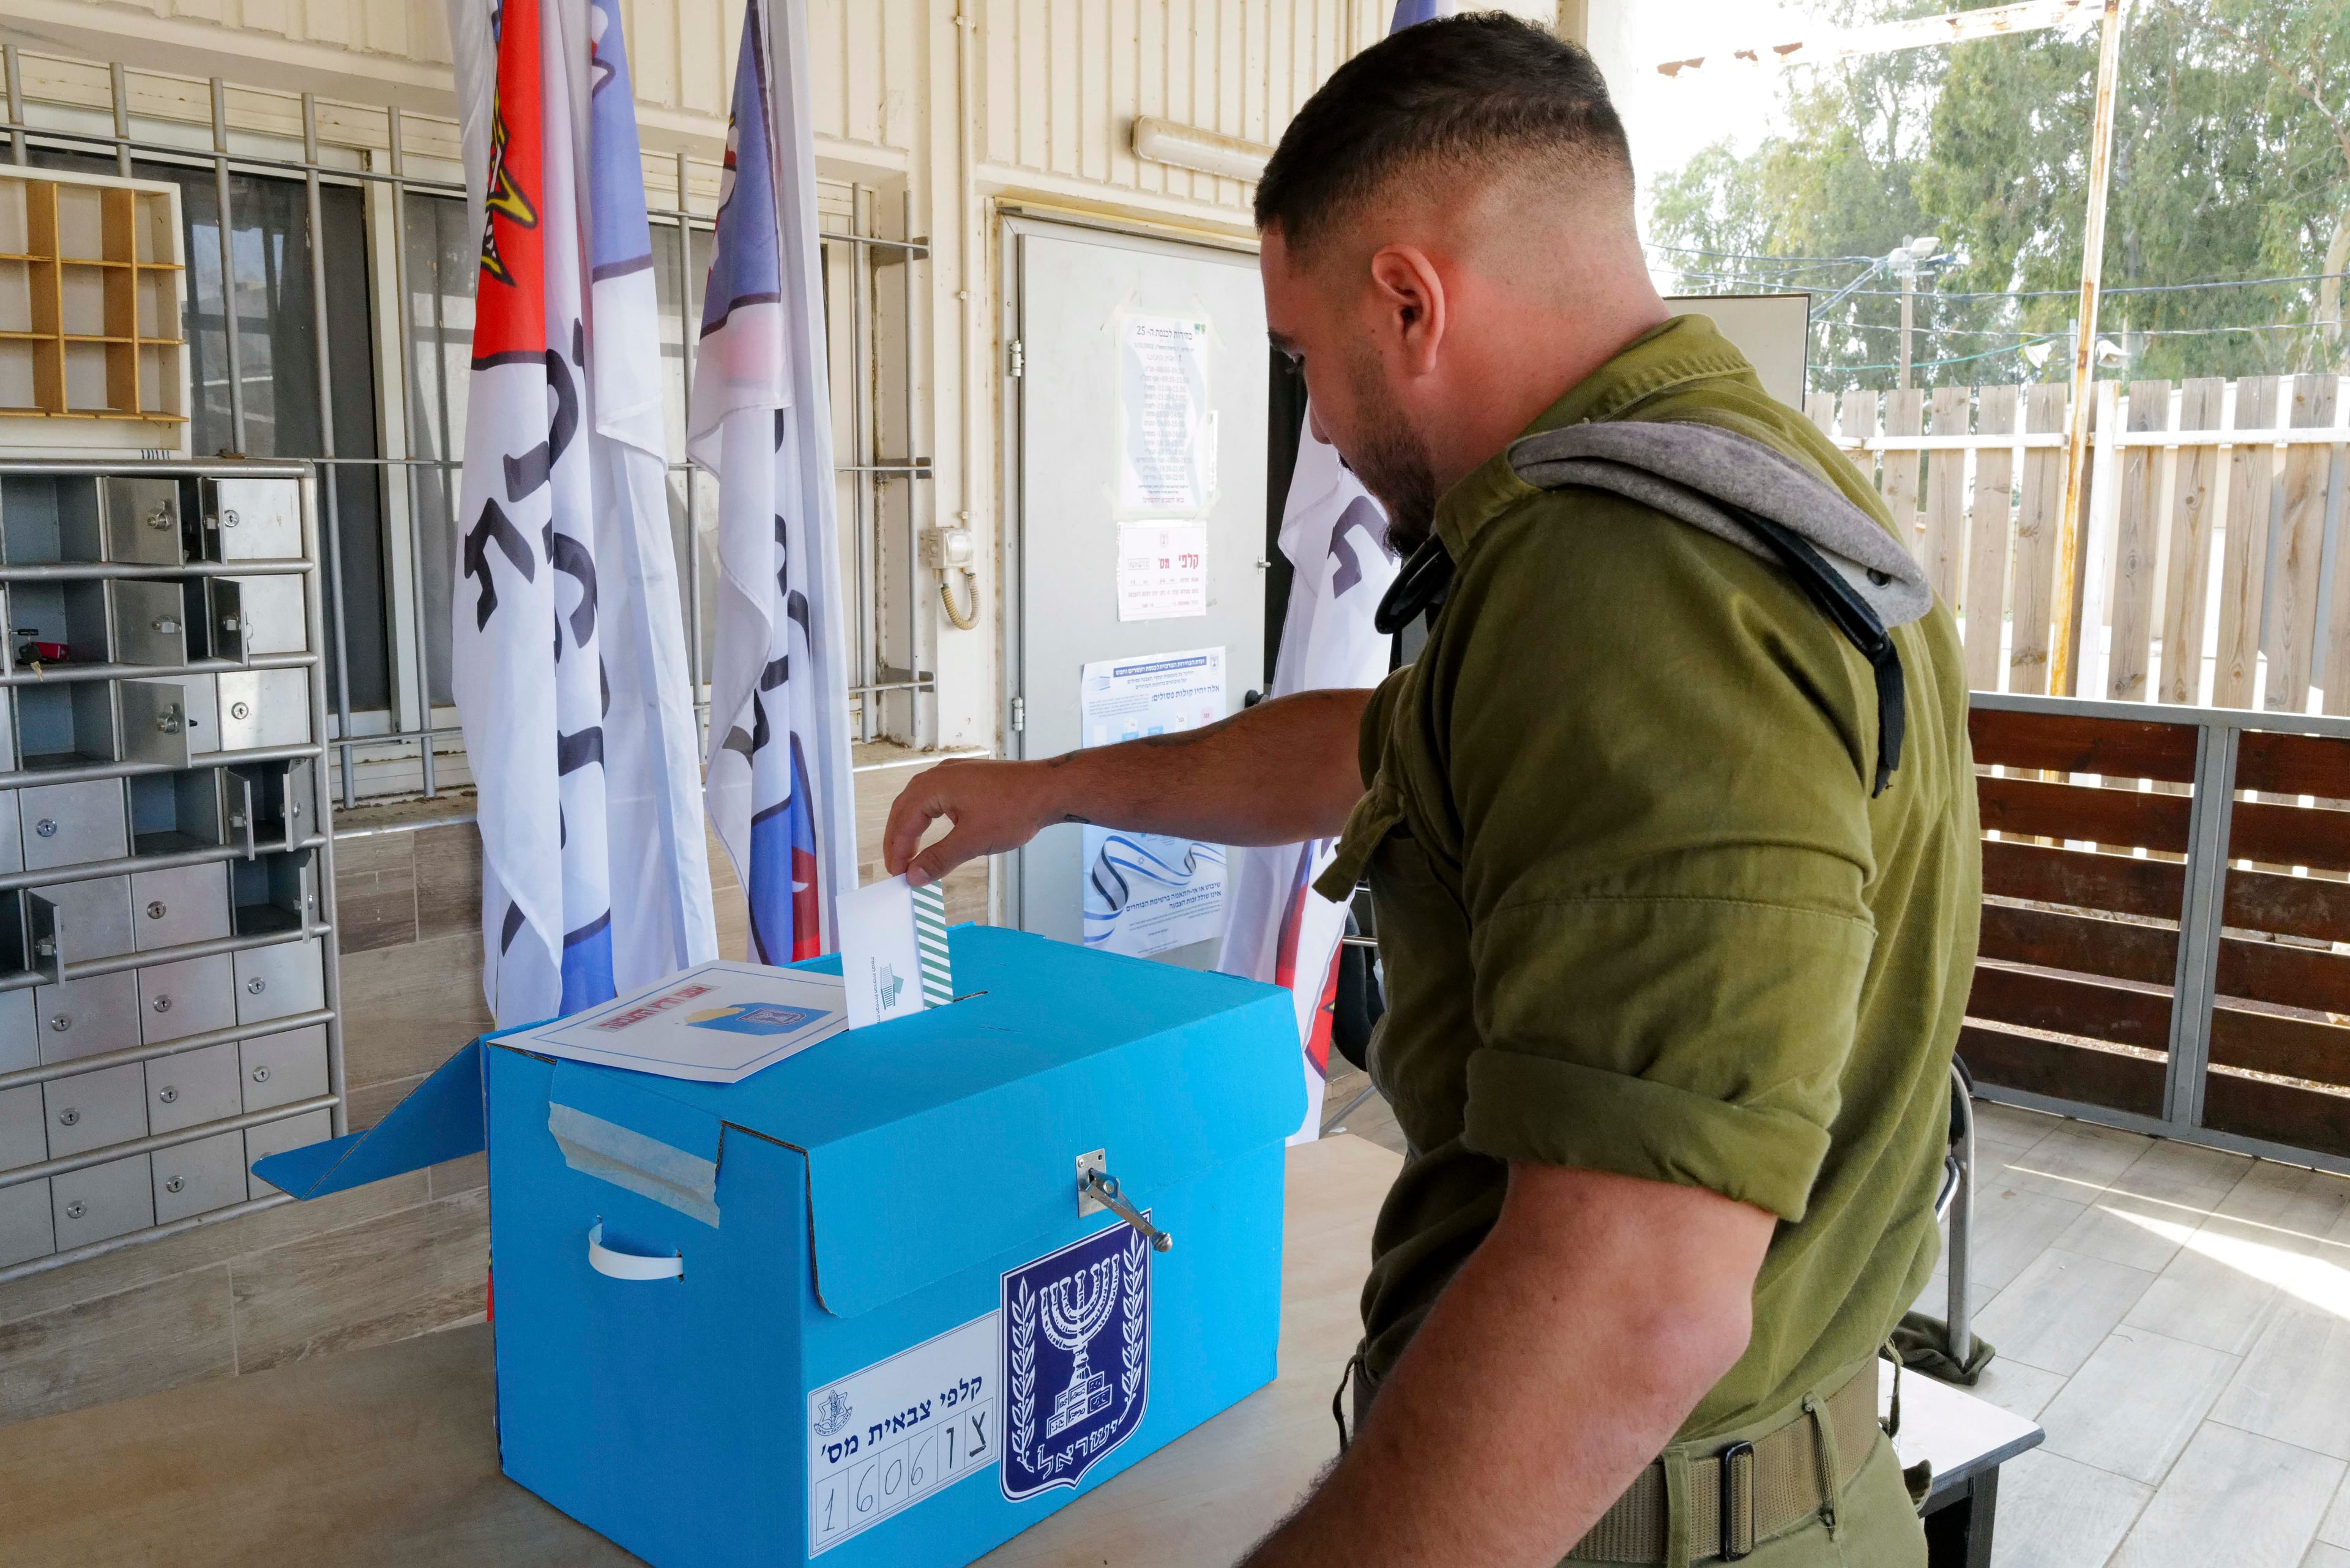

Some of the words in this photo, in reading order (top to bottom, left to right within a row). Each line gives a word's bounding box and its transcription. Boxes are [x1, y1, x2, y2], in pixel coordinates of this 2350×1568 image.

[1137, 326, 1146, 335] 25
[1155, 328, 1172, 338] לכנסת
[1174, 330, 1193, 340] בחירות
[1158, 558, 1169, 569] מס'
[1179, 553, 1198, 569] קלפי
[1146, 663, 1160, 672] לכנסת
[1175, 688, 1193, 698] קולות
[1195, 687, 1206, 695] יהיו
[1207, 684, 1219, 693] אלה
[1152, 692, 1174, 701] פסולים:
[1171, 887, 1198, 900] אי-התאמה
[1149, 894, 1170, 905] ברשימת
[1169, 900, 1185, 909] הצבעה
[1126, 901, 1149, 912] הבוחרים
[940, 1376, 982, 1408] קלפי
[868, 1399, 931, 1446] צבאית
[821, 1435, 859, 1464] מס'
[1037, 1419, 1119, 1480] ישראל
